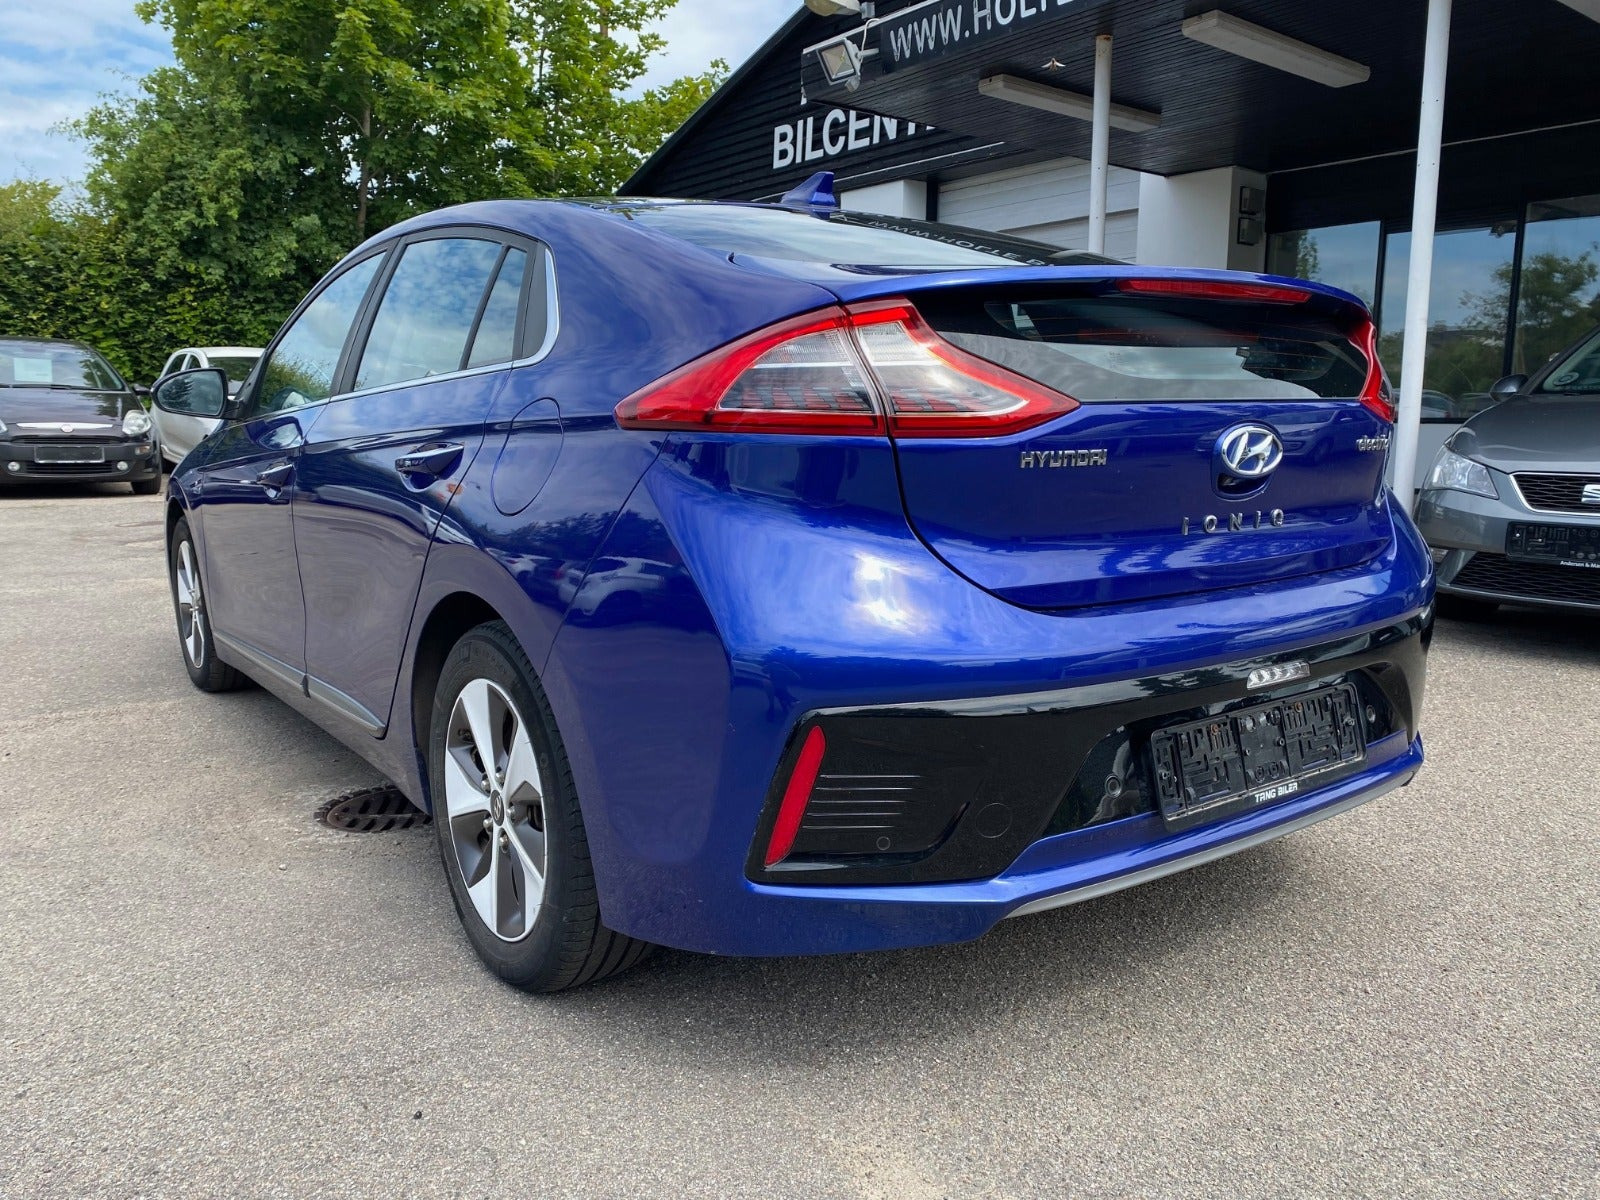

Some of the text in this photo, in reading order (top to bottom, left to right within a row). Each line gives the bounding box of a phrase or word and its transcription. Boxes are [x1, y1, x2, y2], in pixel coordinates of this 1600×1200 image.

[890, 0, 1074, 62] WWW.HOL
[772, 108, 937, 169] BILCEN
[1020, 448, 1108, 469] HYUNDAI
[1182, 508, 1284, 536] IONIQ
[1254, 781, 1298, 803] TANG BILER
